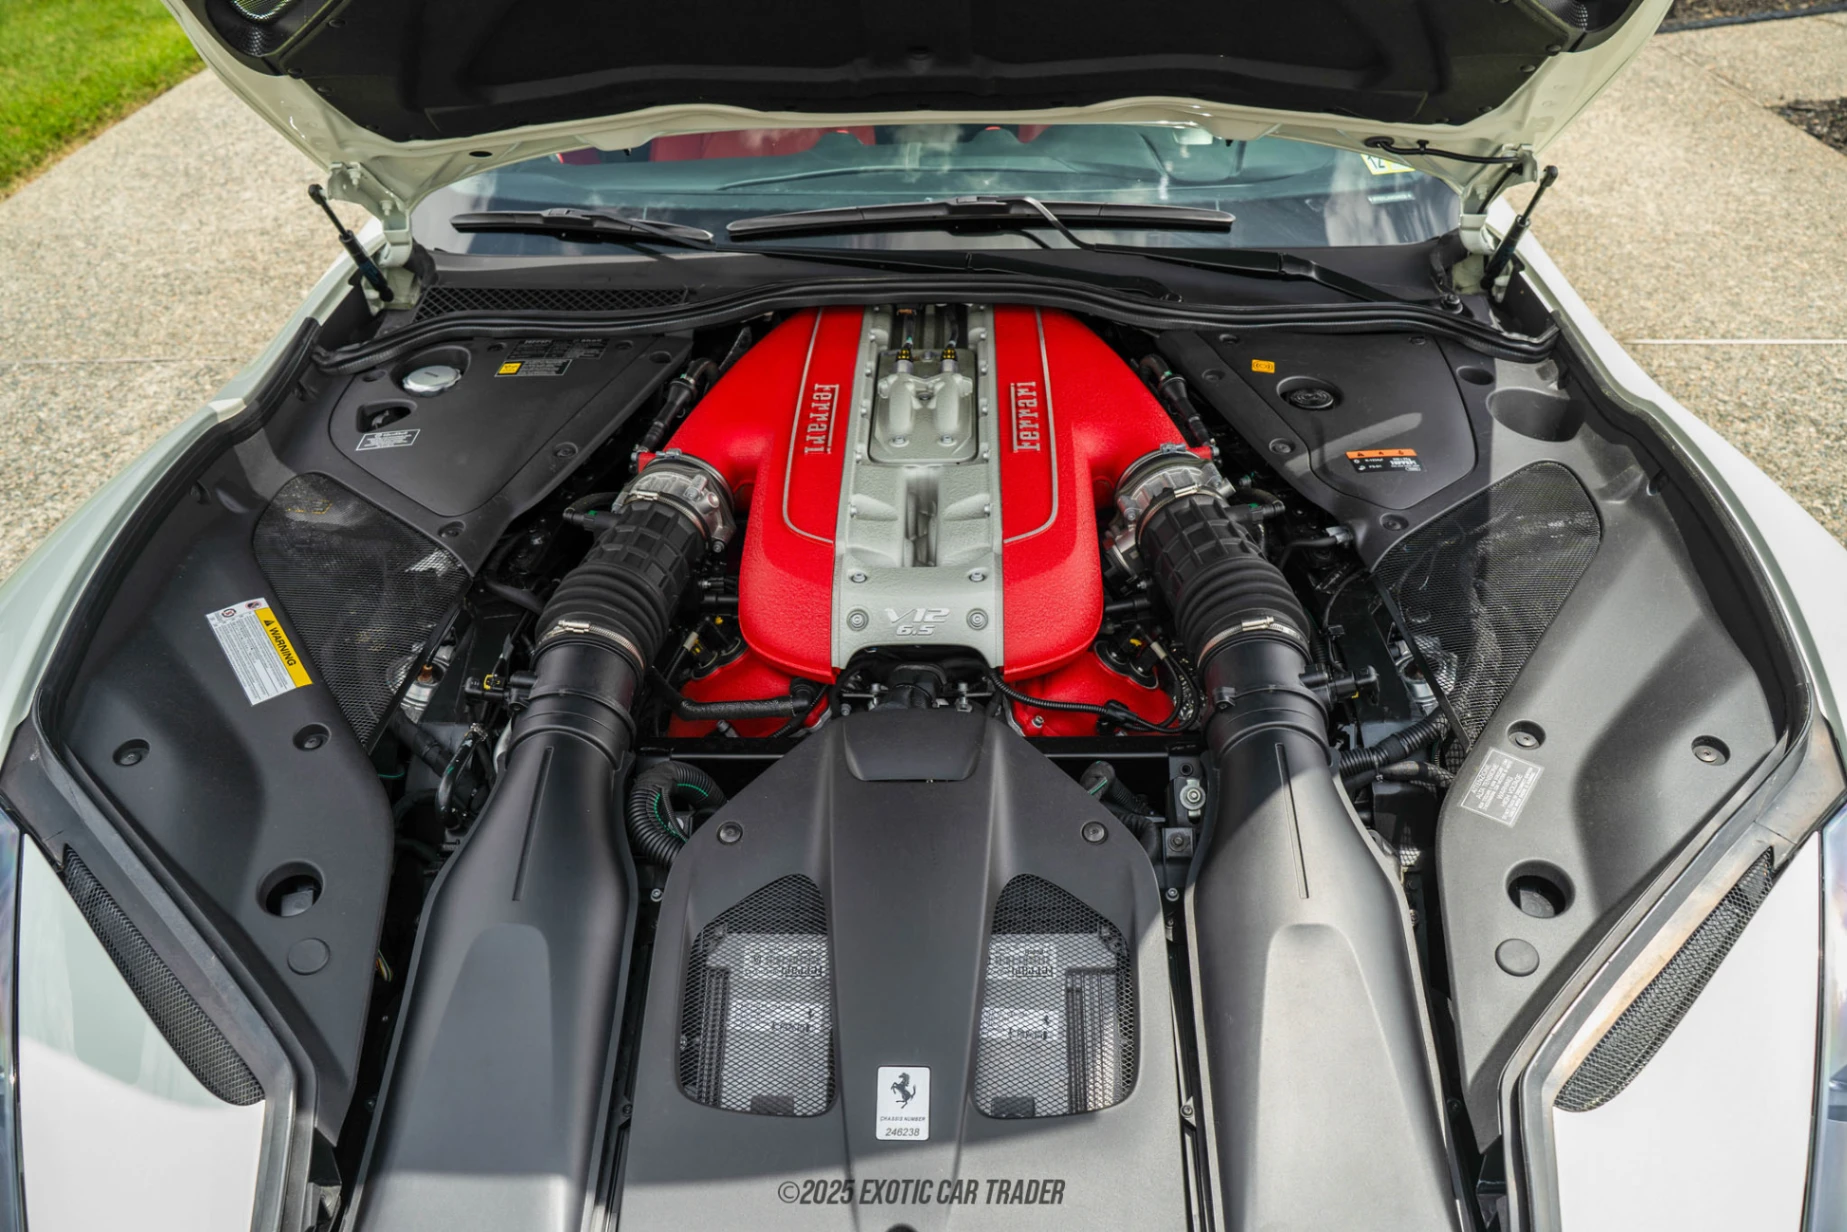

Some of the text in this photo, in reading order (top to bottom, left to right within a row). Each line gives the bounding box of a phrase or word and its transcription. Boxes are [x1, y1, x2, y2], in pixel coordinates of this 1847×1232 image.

[804, 383, 839, 455] Ferrari
[1010, 381, 1041, 454] Ferrari
[884, 607, 951, 624] V12
[896, 625, 935, 637] 6.5
[269, 627, 297, 667] WARNING
[885, 1127, 920, 1137] 246238
